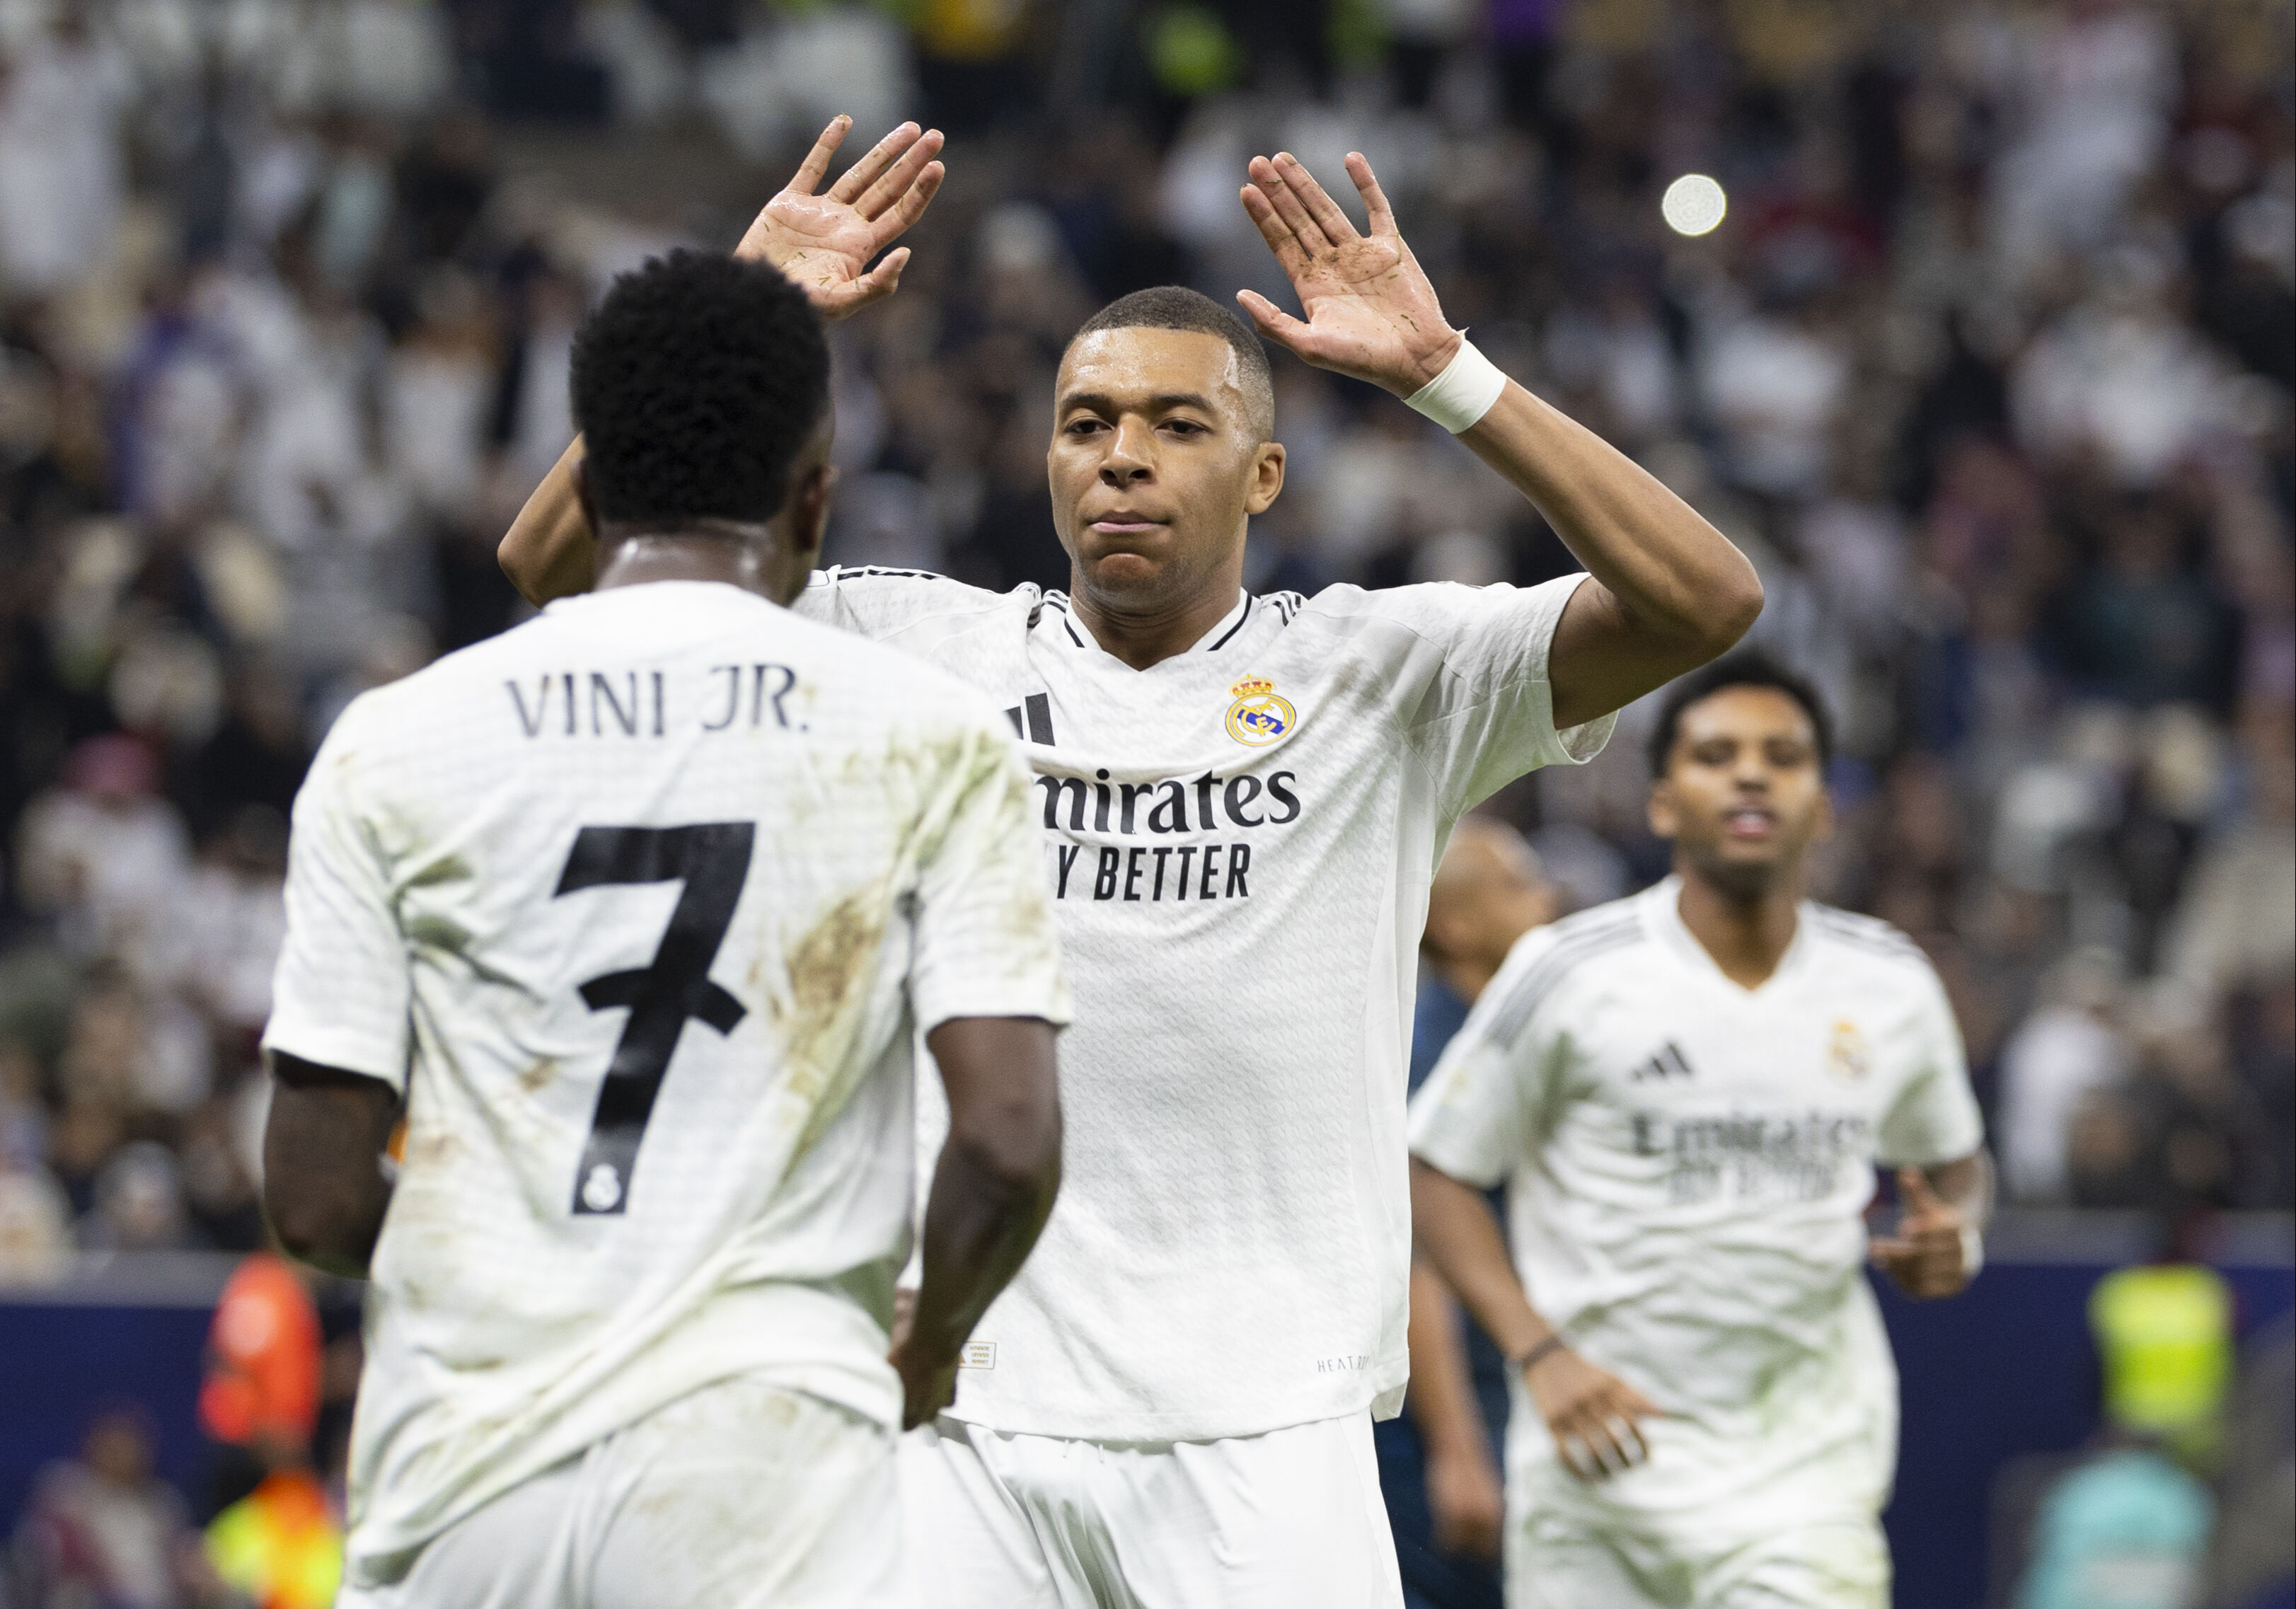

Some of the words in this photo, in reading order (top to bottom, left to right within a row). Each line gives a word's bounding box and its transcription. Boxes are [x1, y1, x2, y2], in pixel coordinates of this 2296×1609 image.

[504, 670, 666, 738] VINI
[702, 662, 809, 733] JR.
[1034, 768, 1302, 836] mirates
[1093, 843, 1251, 902] BETTER
[550, 821, 756, 1216] 7
